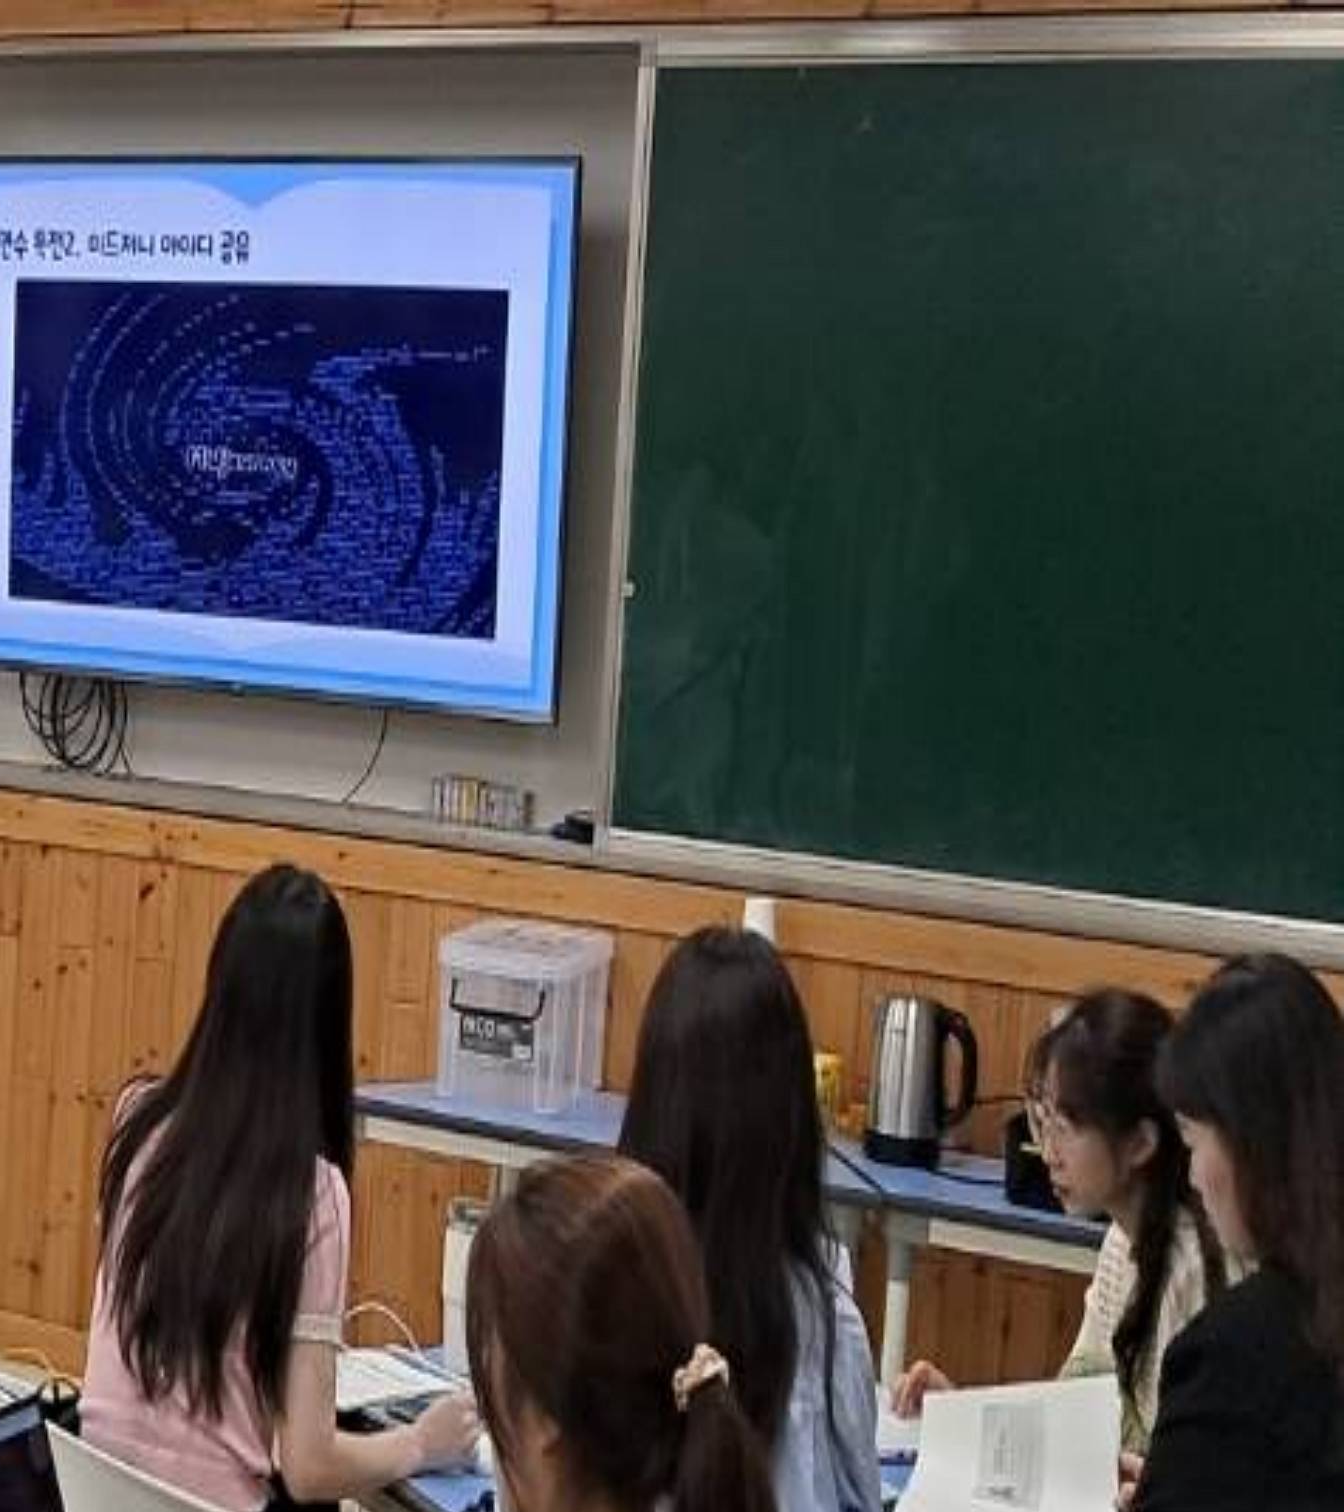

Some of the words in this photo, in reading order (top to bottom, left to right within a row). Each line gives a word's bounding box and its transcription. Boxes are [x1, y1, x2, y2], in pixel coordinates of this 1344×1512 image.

[88, 229, 155, 257] 미드저니
[160, 233, 214, 258] 아이디
[220, 230, 250, 265] 공유
